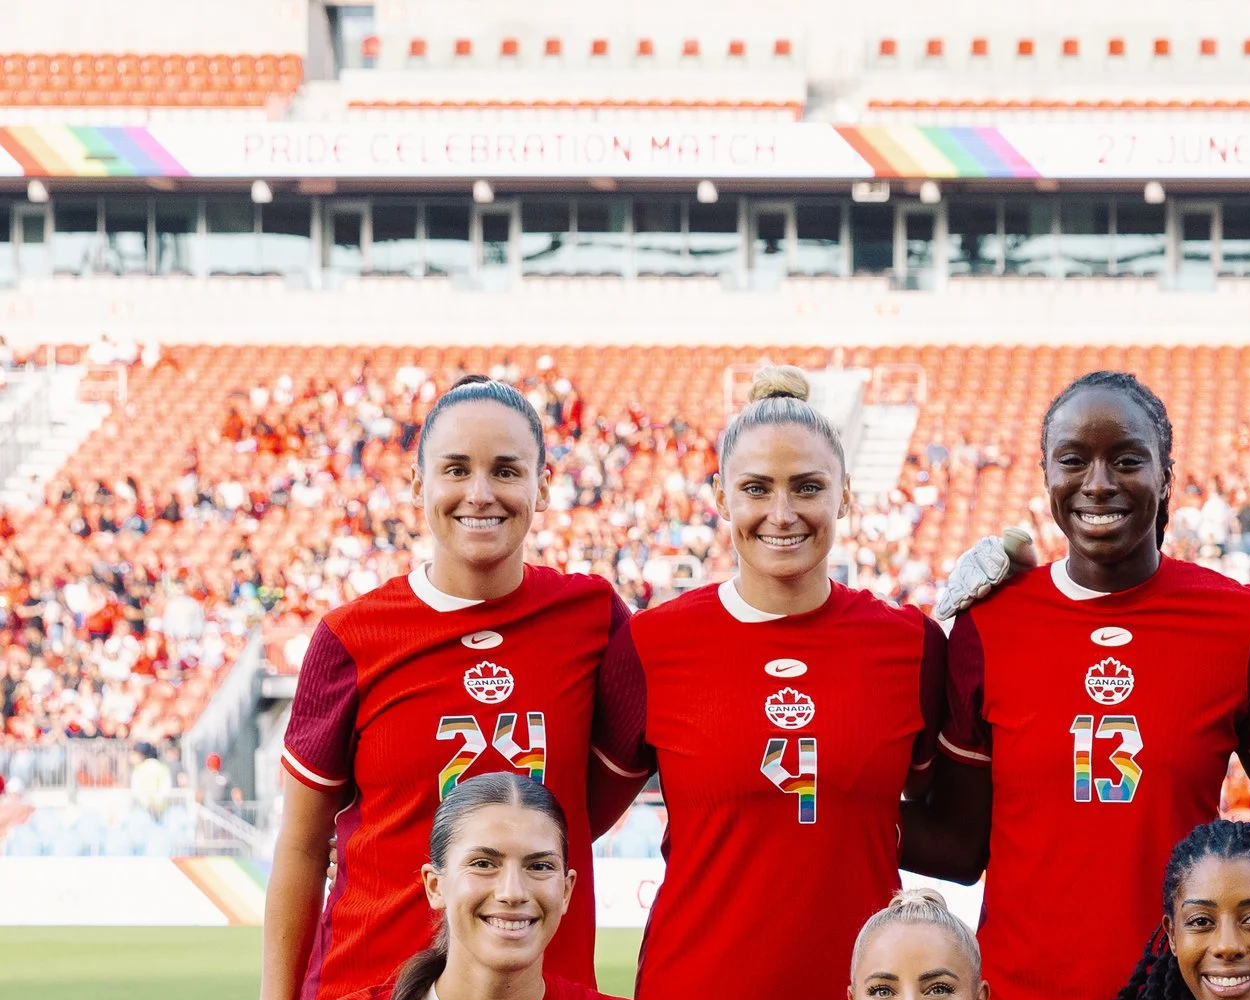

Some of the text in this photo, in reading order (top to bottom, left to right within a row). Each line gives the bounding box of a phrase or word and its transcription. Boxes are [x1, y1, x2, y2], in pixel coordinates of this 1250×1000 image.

[243, 133, 779, 164] PRIDE CELEBRATION MATCH
[1096, 135, 1137, 165] 27
[1156, 135, 1250, 165] JUNE
[466, 678, 511, 687] CANADA
[1087, 678, 1131, 686] CANADA
[767, 705, 812, 713] CANADA
[436, 712, 547, 803] 24
[1069, 714, 1144, 803] 13
[760, 737, 818, 824] 4
